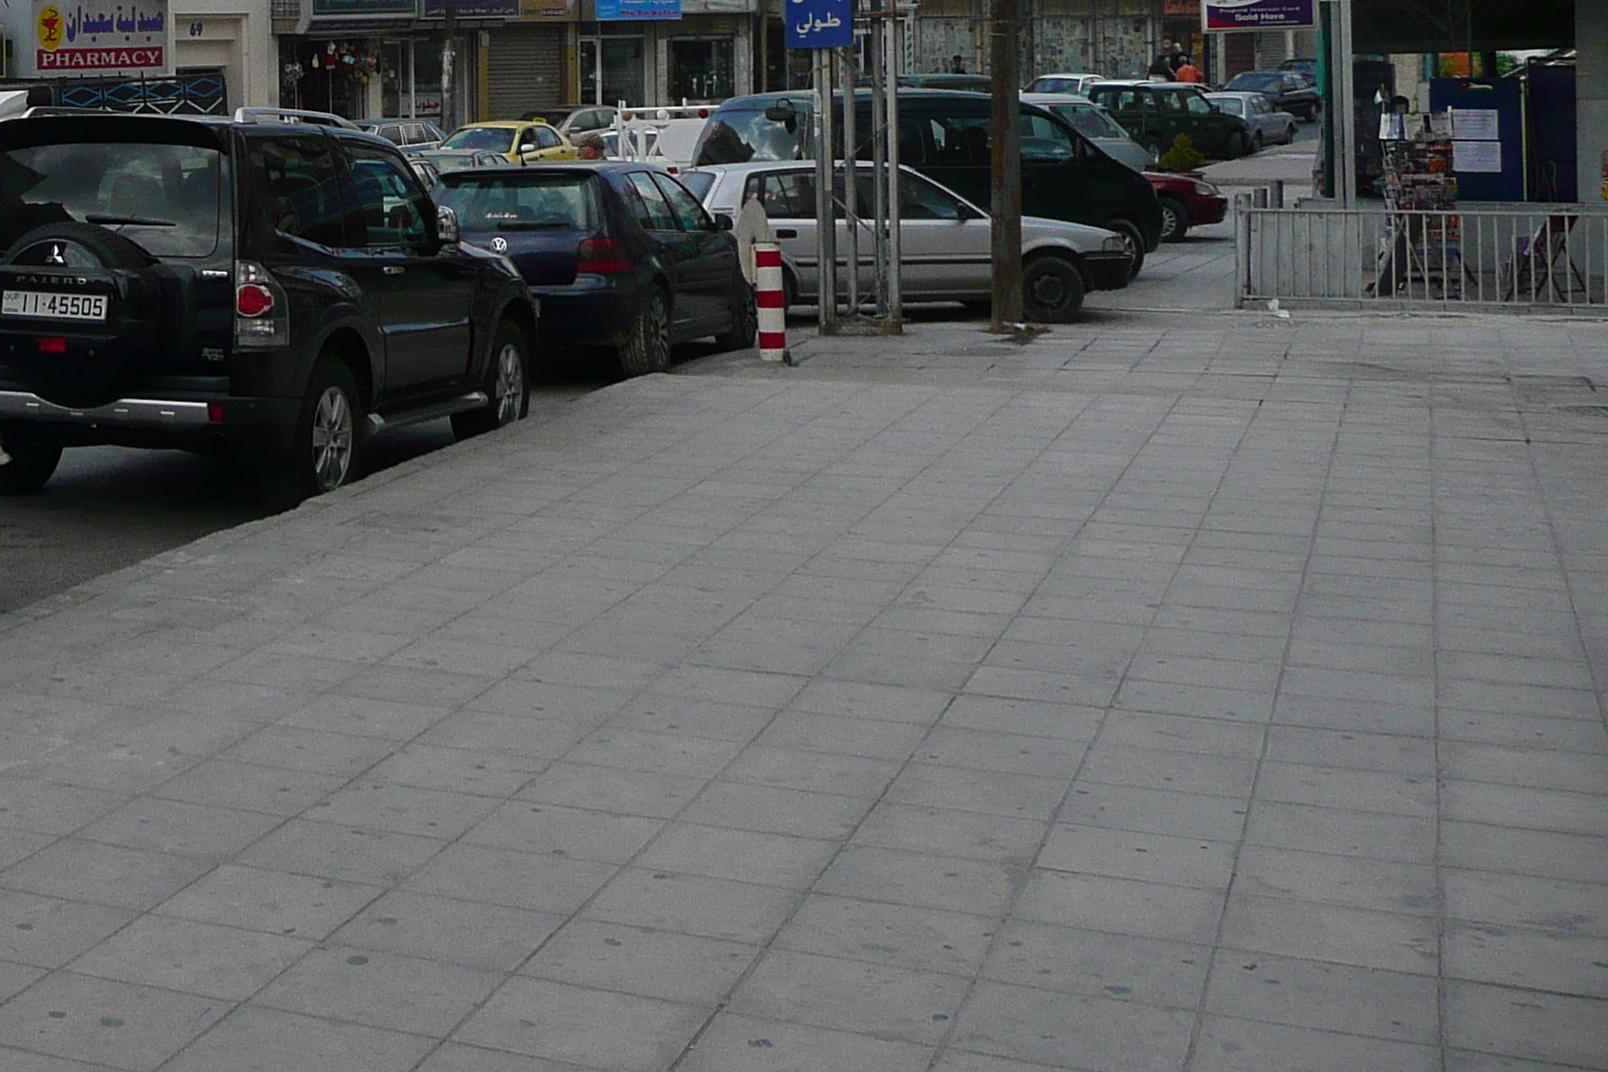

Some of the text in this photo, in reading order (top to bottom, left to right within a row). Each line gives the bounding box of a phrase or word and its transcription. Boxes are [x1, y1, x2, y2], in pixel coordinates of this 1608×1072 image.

[116, 5, 164, 42] صيدلية
[796, 12, 841, 38] طولي
[42, 50, 159, 67] PHARMACY
[16, 275, 87, 285] PAJERO
